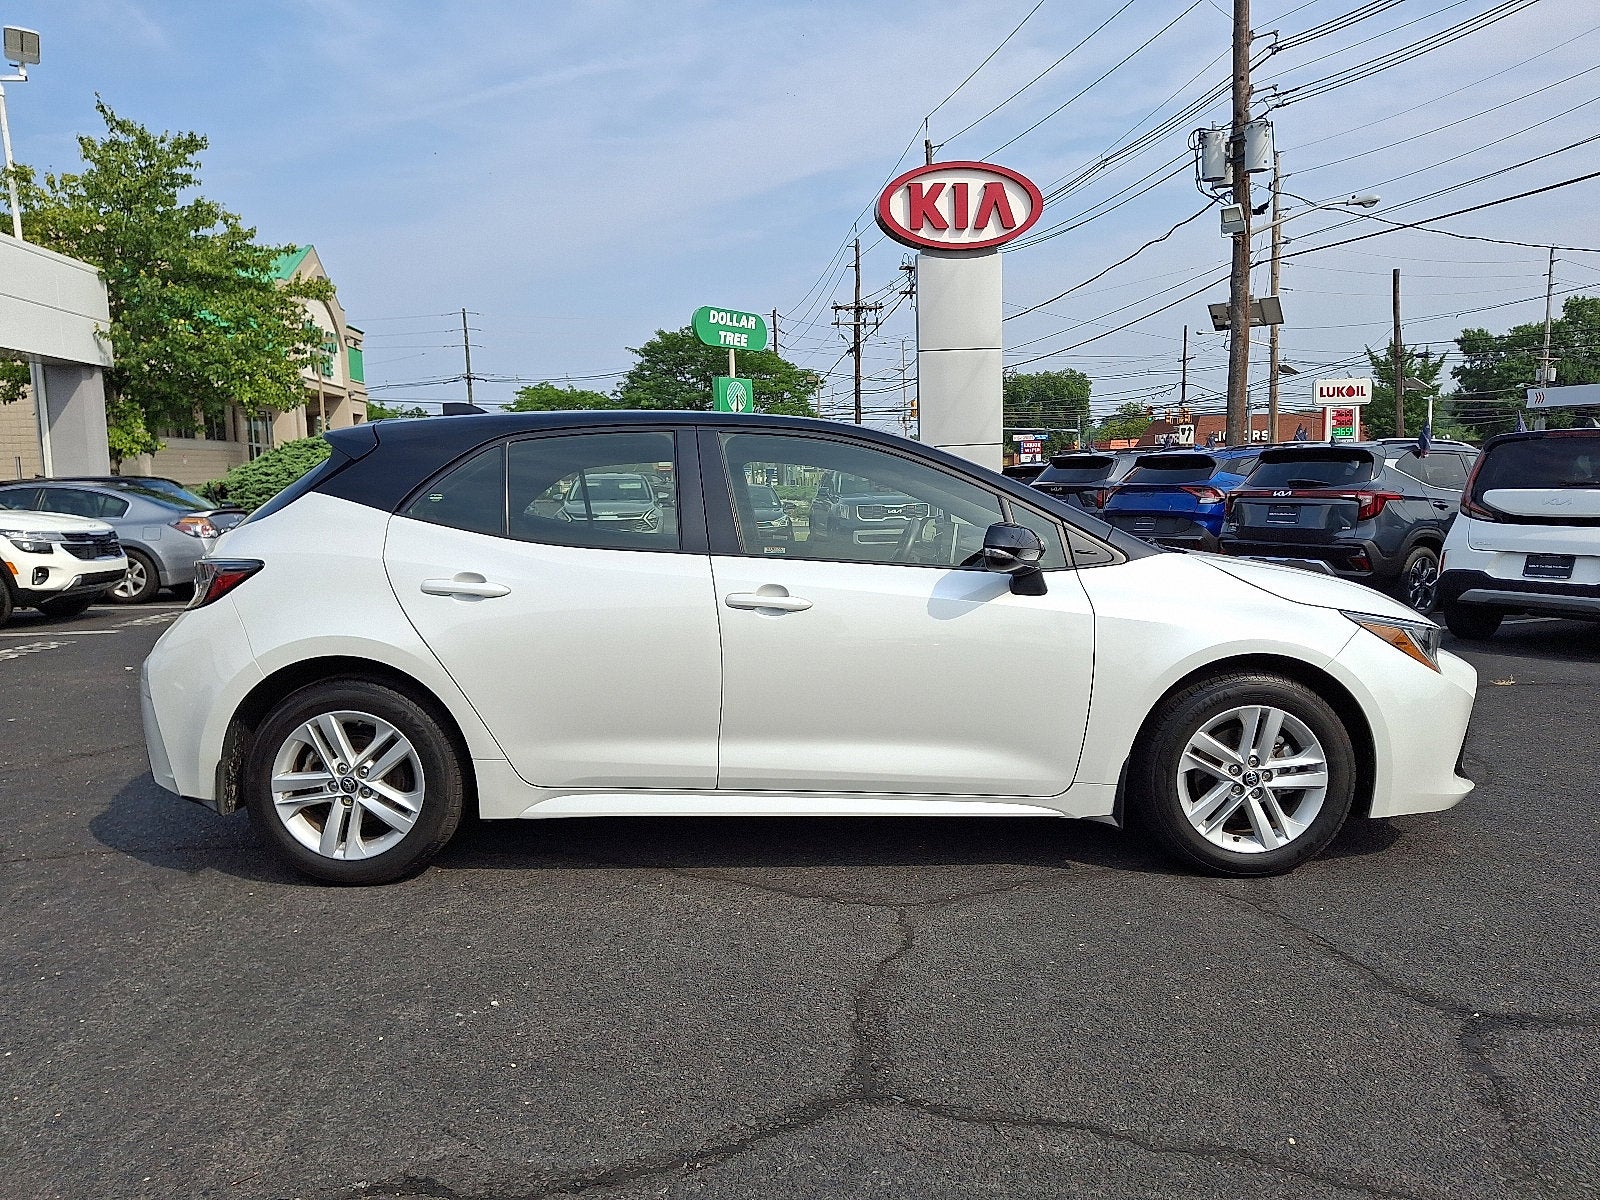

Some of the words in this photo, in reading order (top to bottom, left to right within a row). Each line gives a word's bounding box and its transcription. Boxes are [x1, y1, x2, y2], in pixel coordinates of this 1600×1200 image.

[907, 182, 1016, 230] KIA
[709, 309, 756, 329] DOLLAR
[718, 330, 748, 347] TREE
[1319, 384, 1366, 398] LUKOIL
